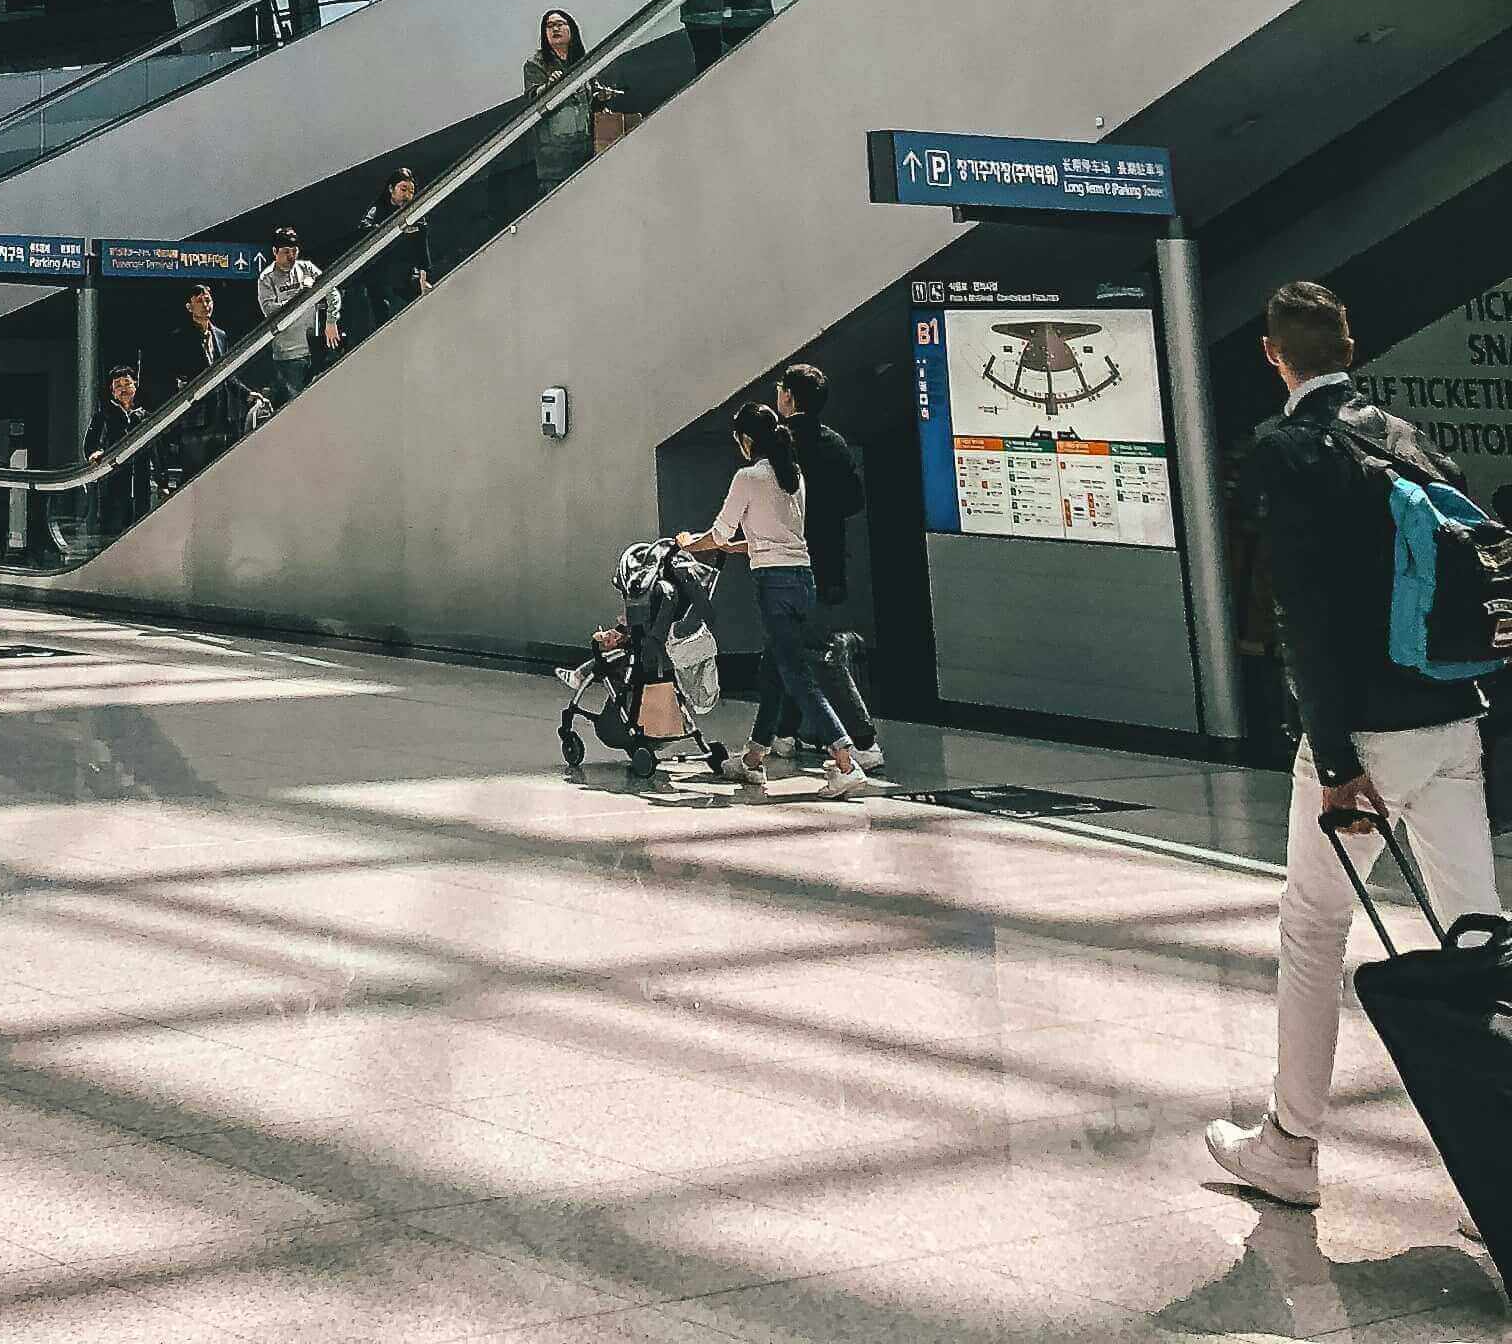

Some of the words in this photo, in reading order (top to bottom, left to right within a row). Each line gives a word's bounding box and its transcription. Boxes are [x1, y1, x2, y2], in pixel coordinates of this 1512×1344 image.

[932, 156, 946, 182] P
[1063, 180, 1085, 197] Long
[1112, 183, 1142, 200] Parking
[29, 256, 61, 271] Parking
[61, 257, 81, 269] Area
[916, 317, 940, 345] B1
[1468, 334, 1512, 367] SN
